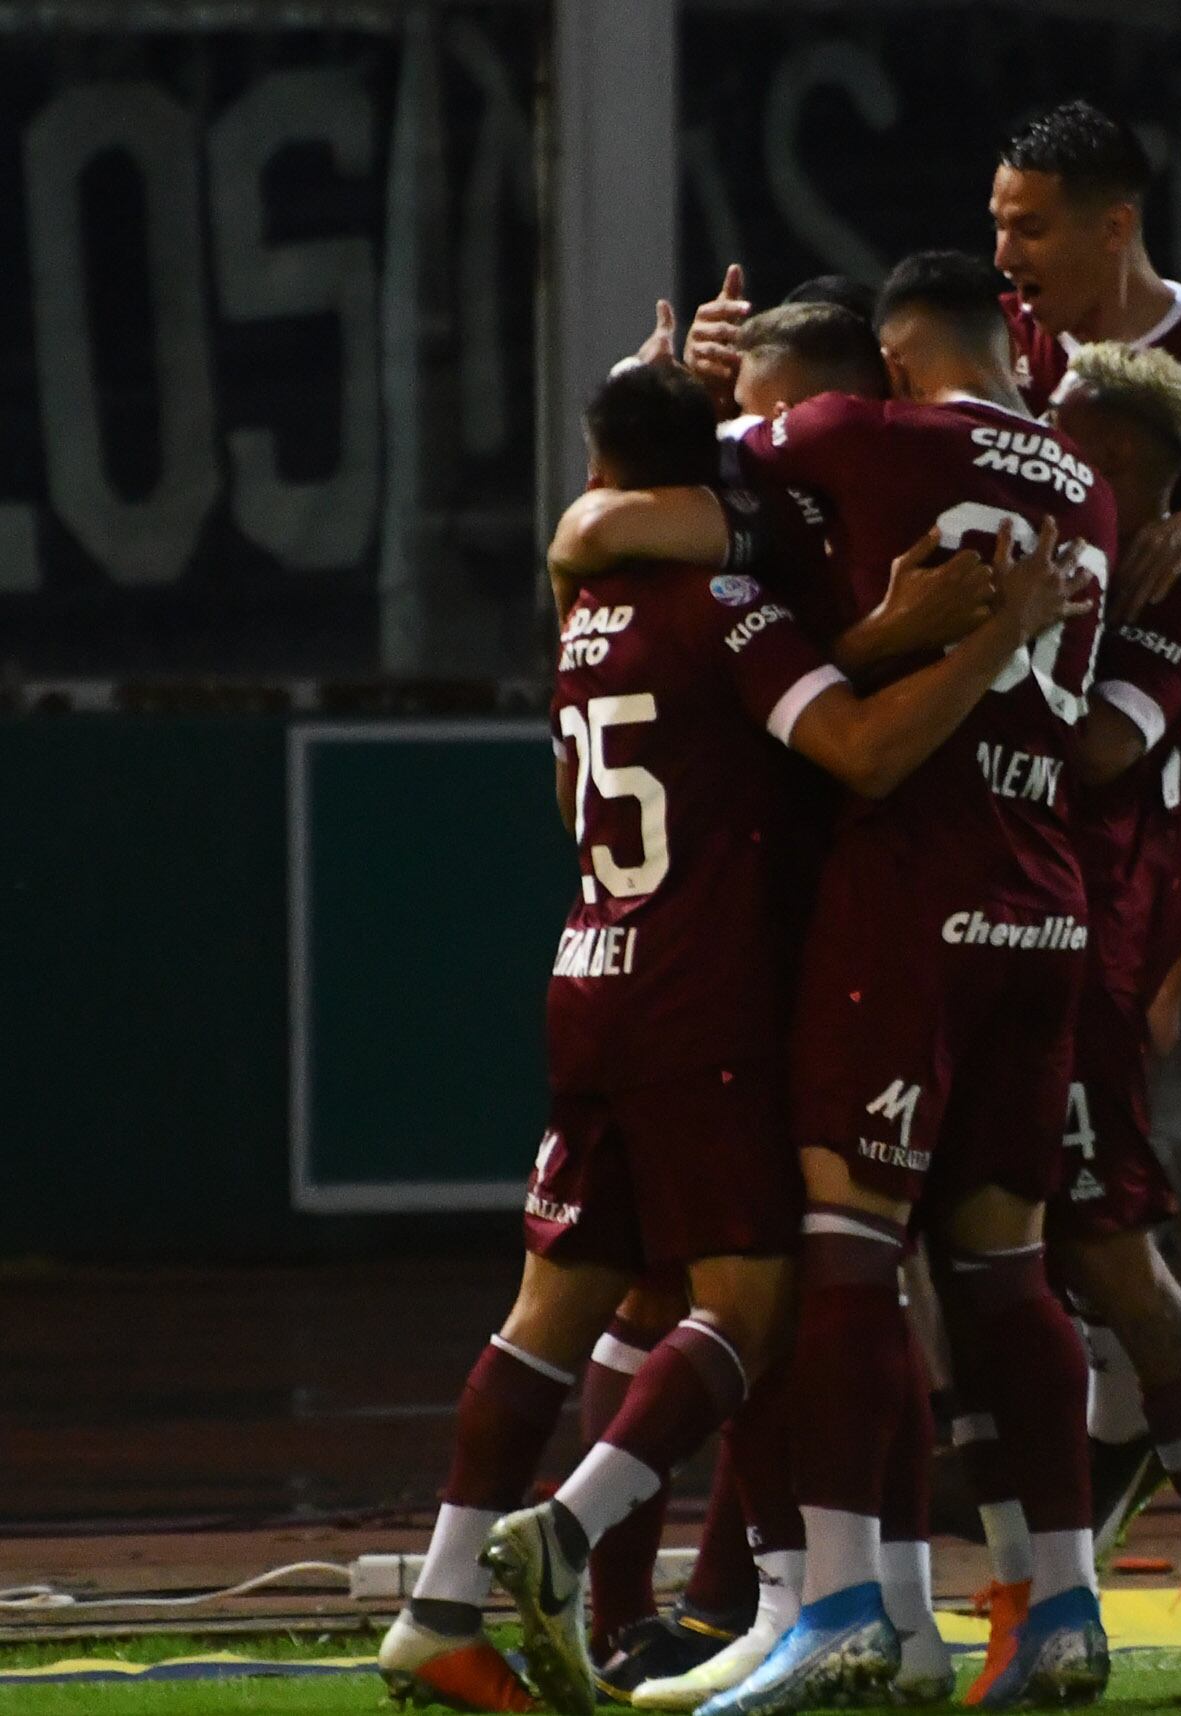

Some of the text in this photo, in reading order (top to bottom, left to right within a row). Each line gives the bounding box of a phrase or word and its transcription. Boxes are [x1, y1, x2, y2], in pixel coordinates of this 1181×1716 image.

[0, 66, 380, 590] OS
[970, 427, 1095, 488] CIUDAD
[972, 449, 1088, 505] MOTO
[560, 604, 635, 643] DAD
